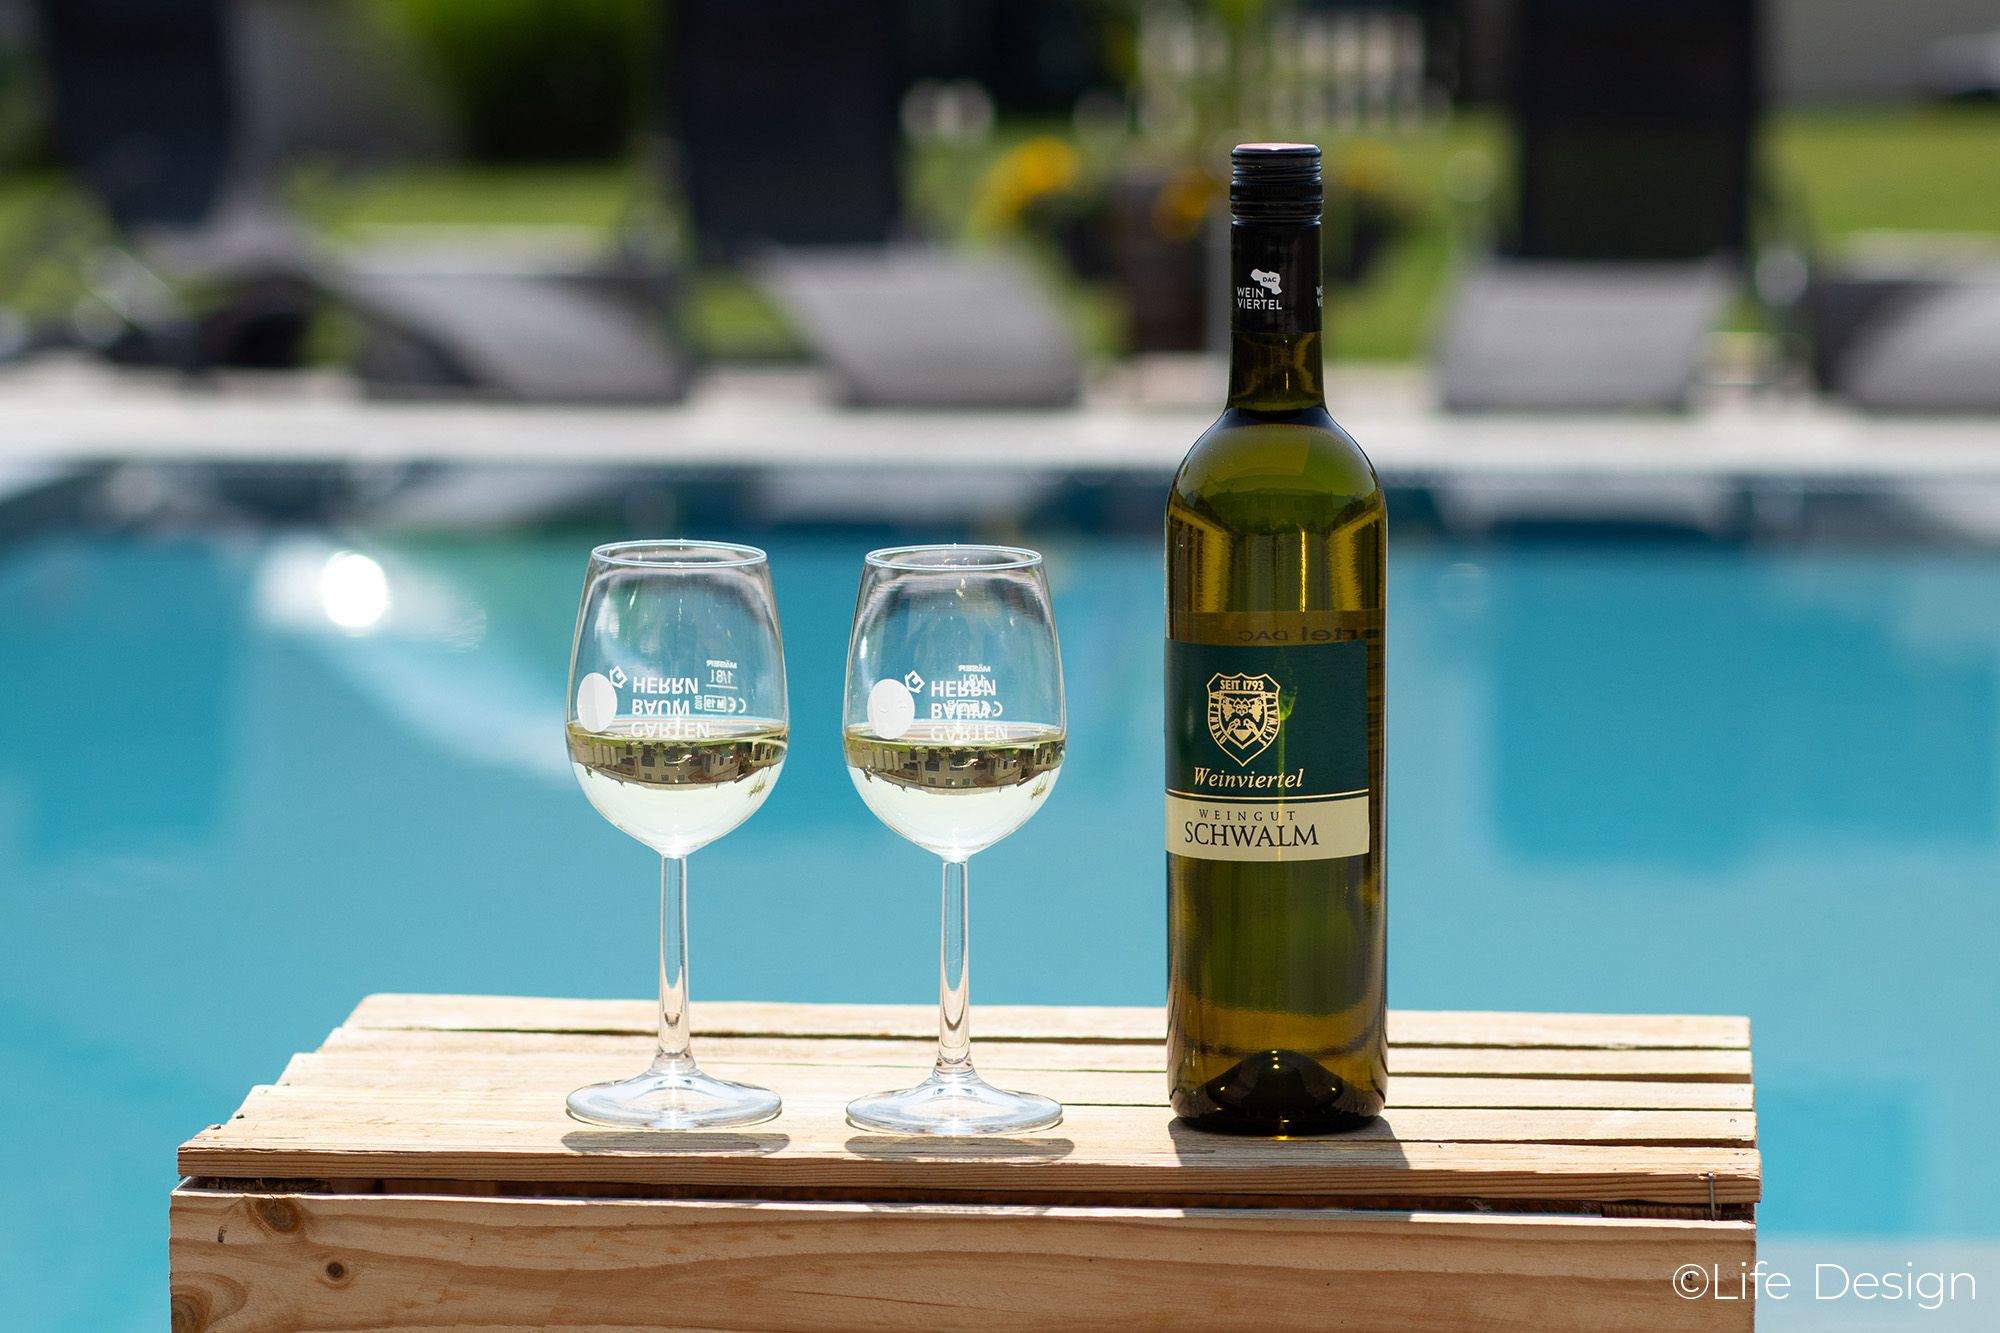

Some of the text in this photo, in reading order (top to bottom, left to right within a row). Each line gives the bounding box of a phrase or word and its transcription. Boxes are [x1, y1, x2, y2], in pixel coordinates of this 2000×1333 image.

[1237, 286, 1265, 298] WEIN
[1237, 298, 1282, 310] VIERTEL
[1220, 679, 1264, 691] SEIT 1793
[1194, 767, 1304, 788] Weinviertel
[1199, 808, 1296, 822] WEINGUT
[1185, 821, 1319, 847] SCHWALM
